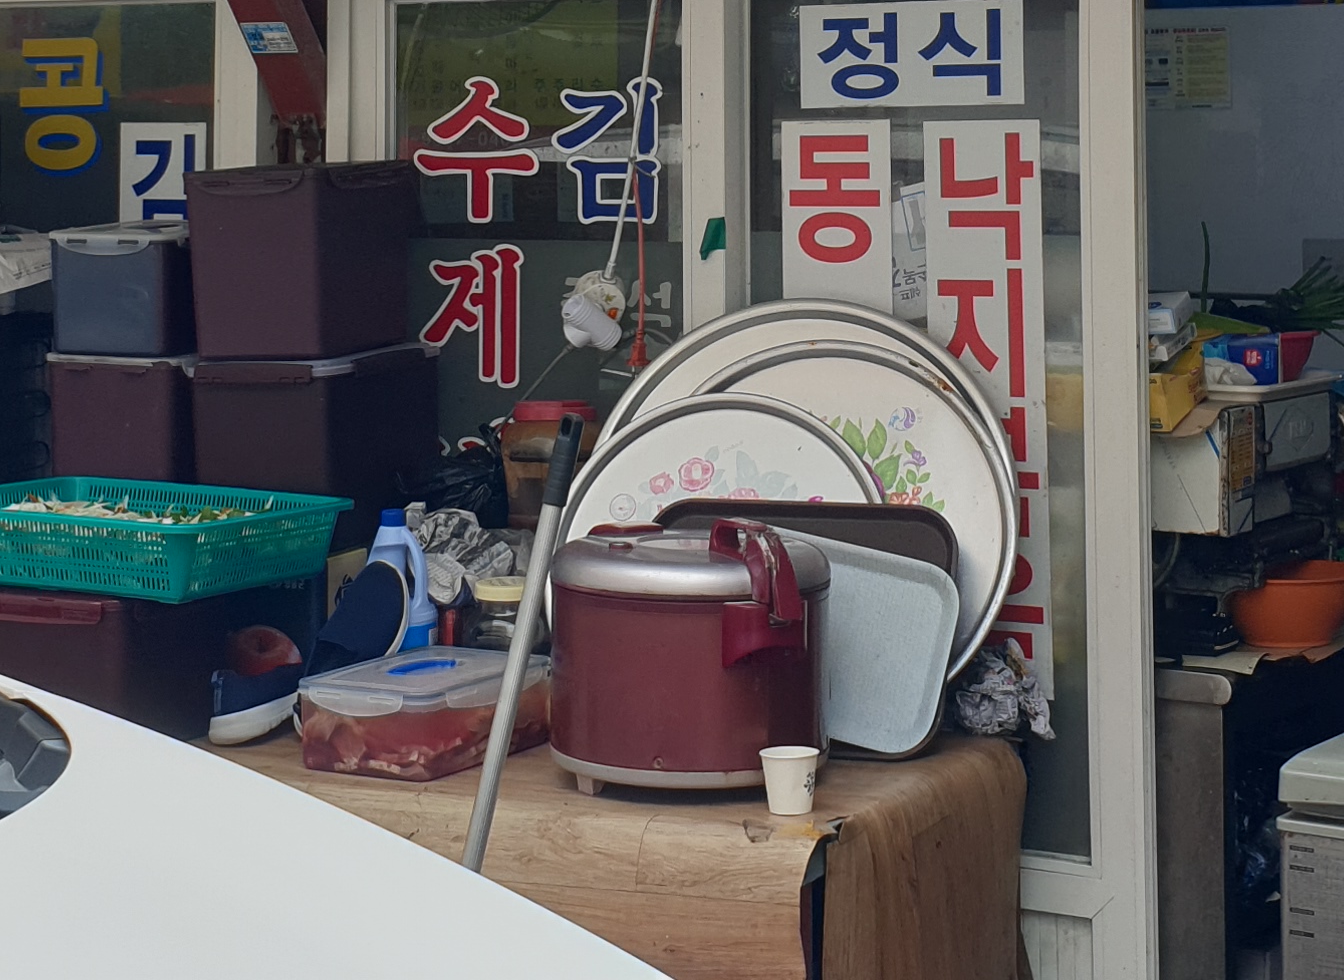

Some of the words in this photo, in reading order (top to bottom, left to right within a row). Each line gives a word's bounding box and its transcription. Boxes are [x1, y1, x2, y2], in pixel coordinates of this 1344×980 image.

[19, 36, 110, 178] 공
[818, 8, 1003, 101] 정식
[413, 75, 540, 460] 수제
[788, 133, 881, 264] 동
[937, 132, 1045, 660] 낙지
